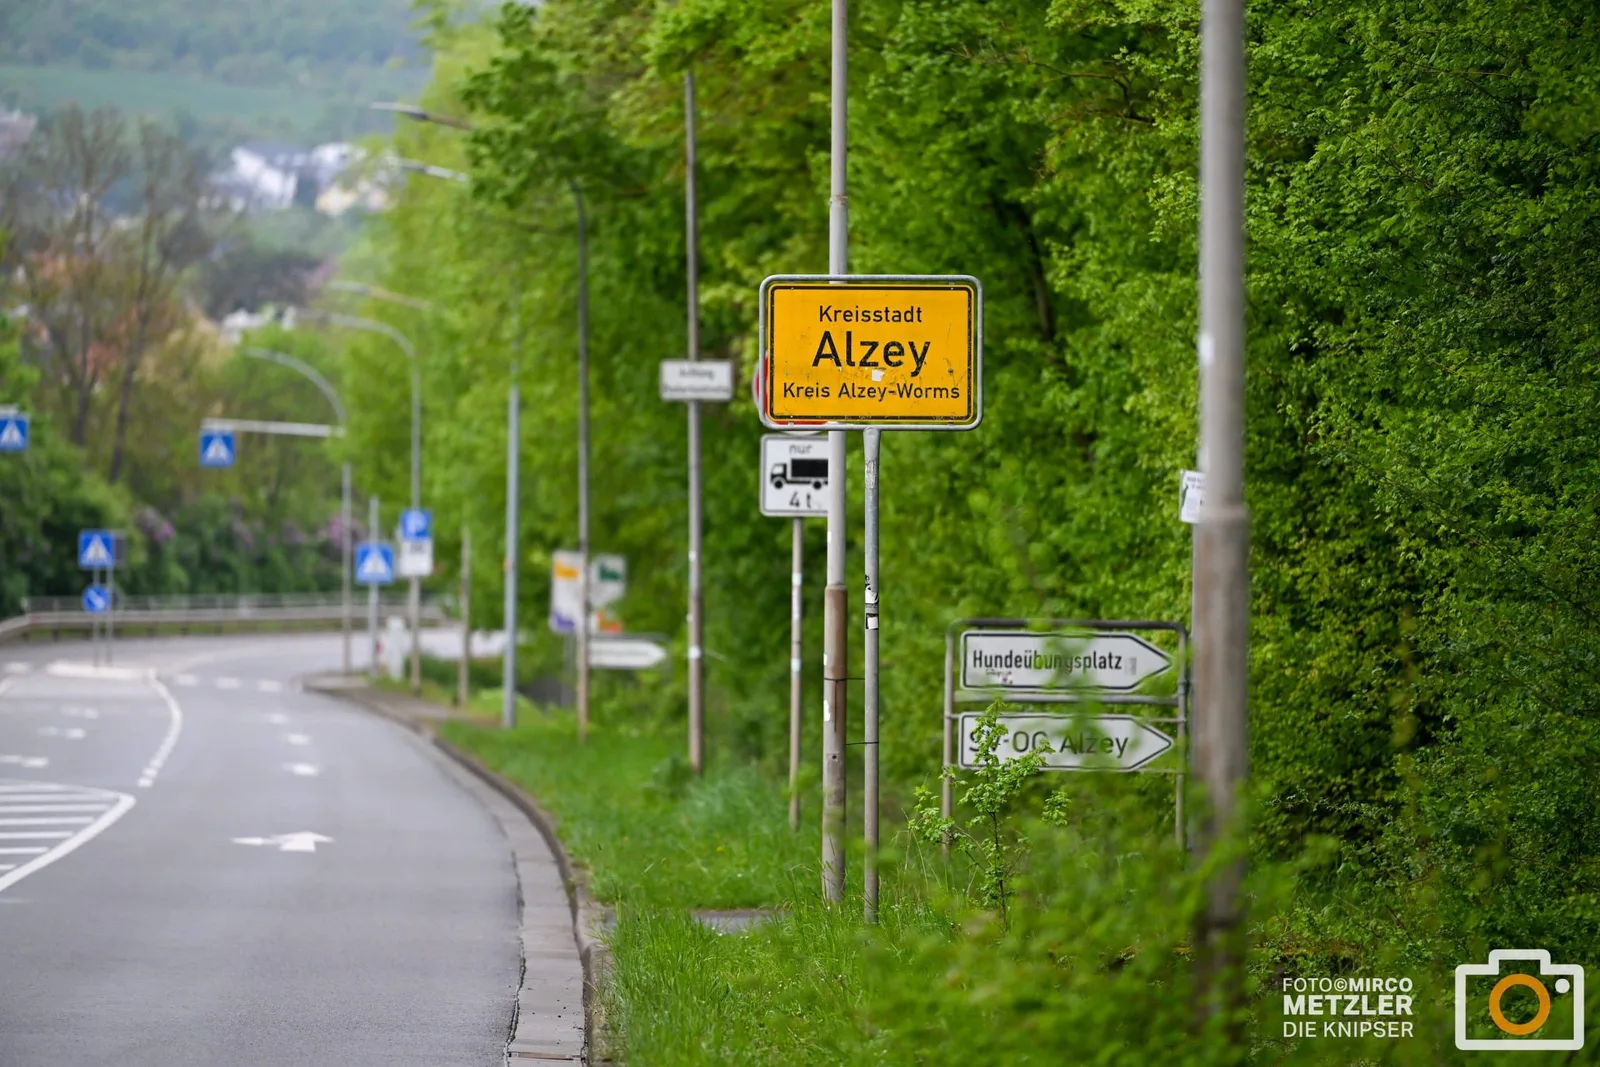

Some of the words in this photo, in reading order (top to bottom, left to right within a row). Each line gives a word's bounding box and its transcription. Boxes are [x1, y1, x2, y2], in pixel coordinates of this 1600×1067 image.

[819, 305, 922, 323] Kreisstadt
[812, 331, 931, 377] Alzey
[783, 382, 831, 399] Kreis
[838, 382, 960, 402] Alzey-Worms
[788, 443, 813, 455] nur
[789, 491, 801, 508] 4
[806, 492, 812, 509] t
[973, 650, 1122, 673] Hundeübungsplatz
[1059, 731, 1129, 757] Alzey
